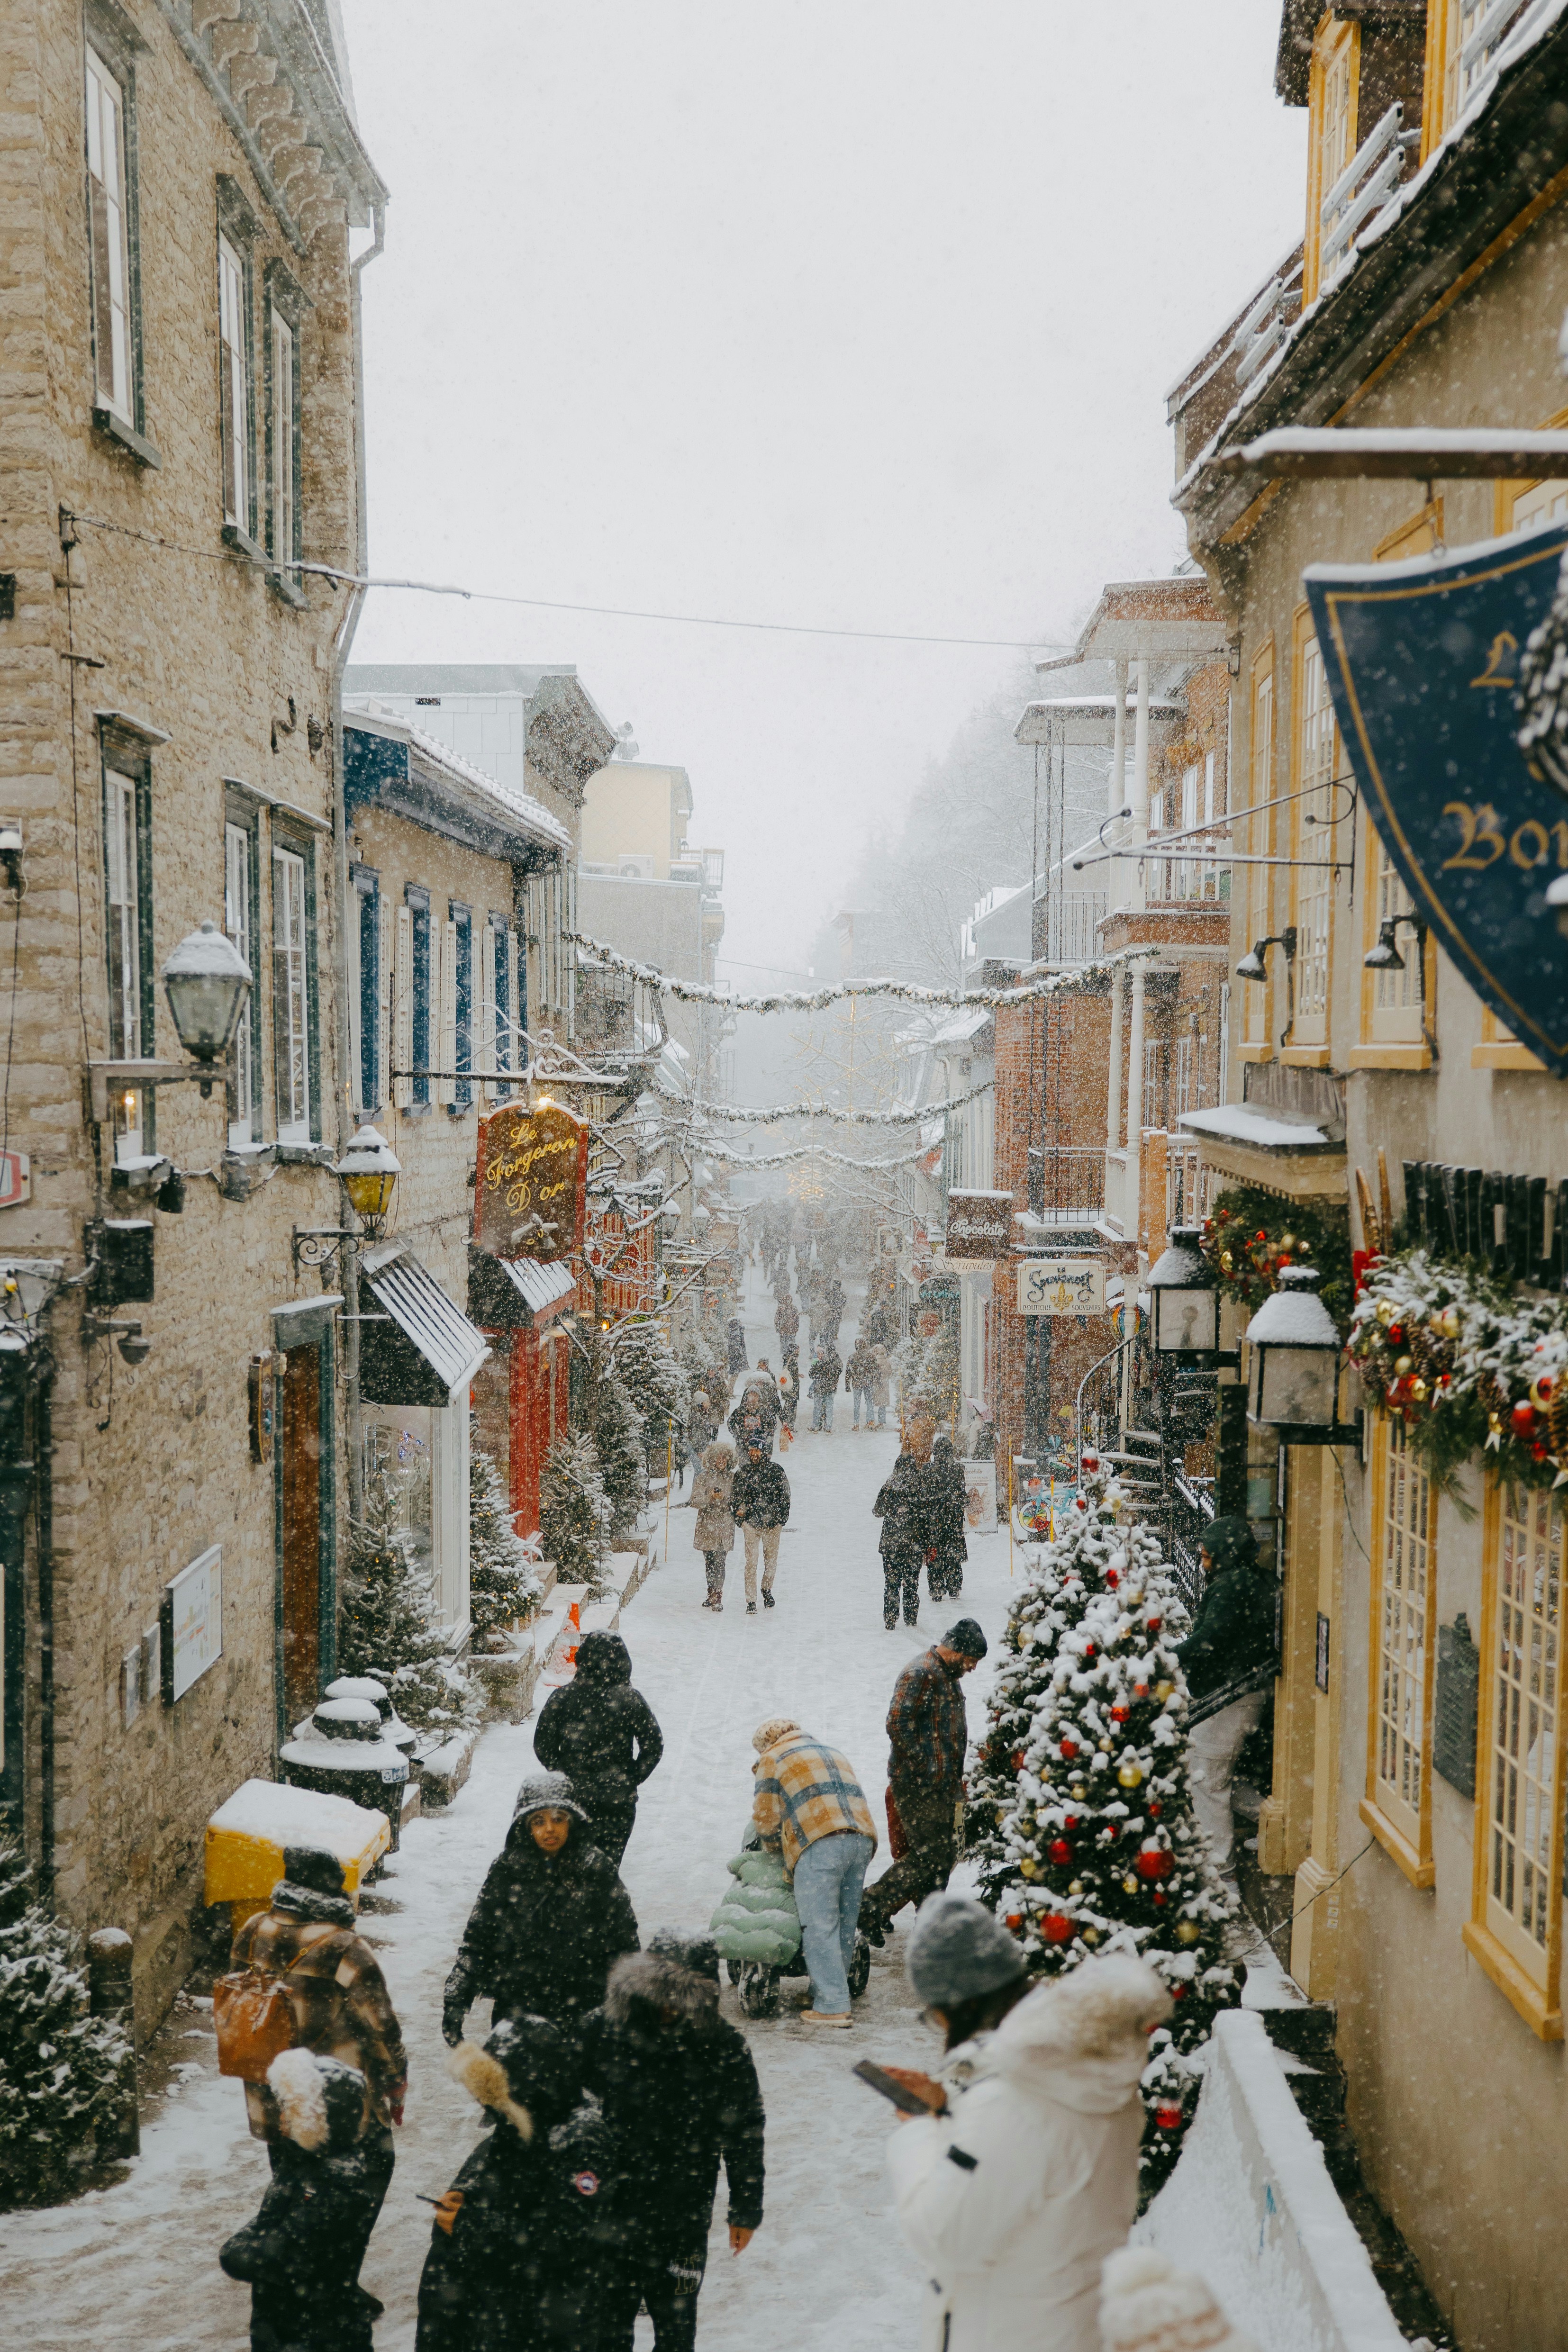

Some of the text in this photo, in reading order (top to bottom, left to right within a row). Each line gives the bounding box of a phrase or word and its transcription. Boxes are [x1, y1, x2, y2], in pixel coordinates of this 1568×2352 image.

[510, 1122, 537, 1149] Le
[487, 1138, 578, 1190] Forgeron
[950, 1219, 1007, 1239] Chocolato
[934, 1257, 993, 1274] Scrupules
